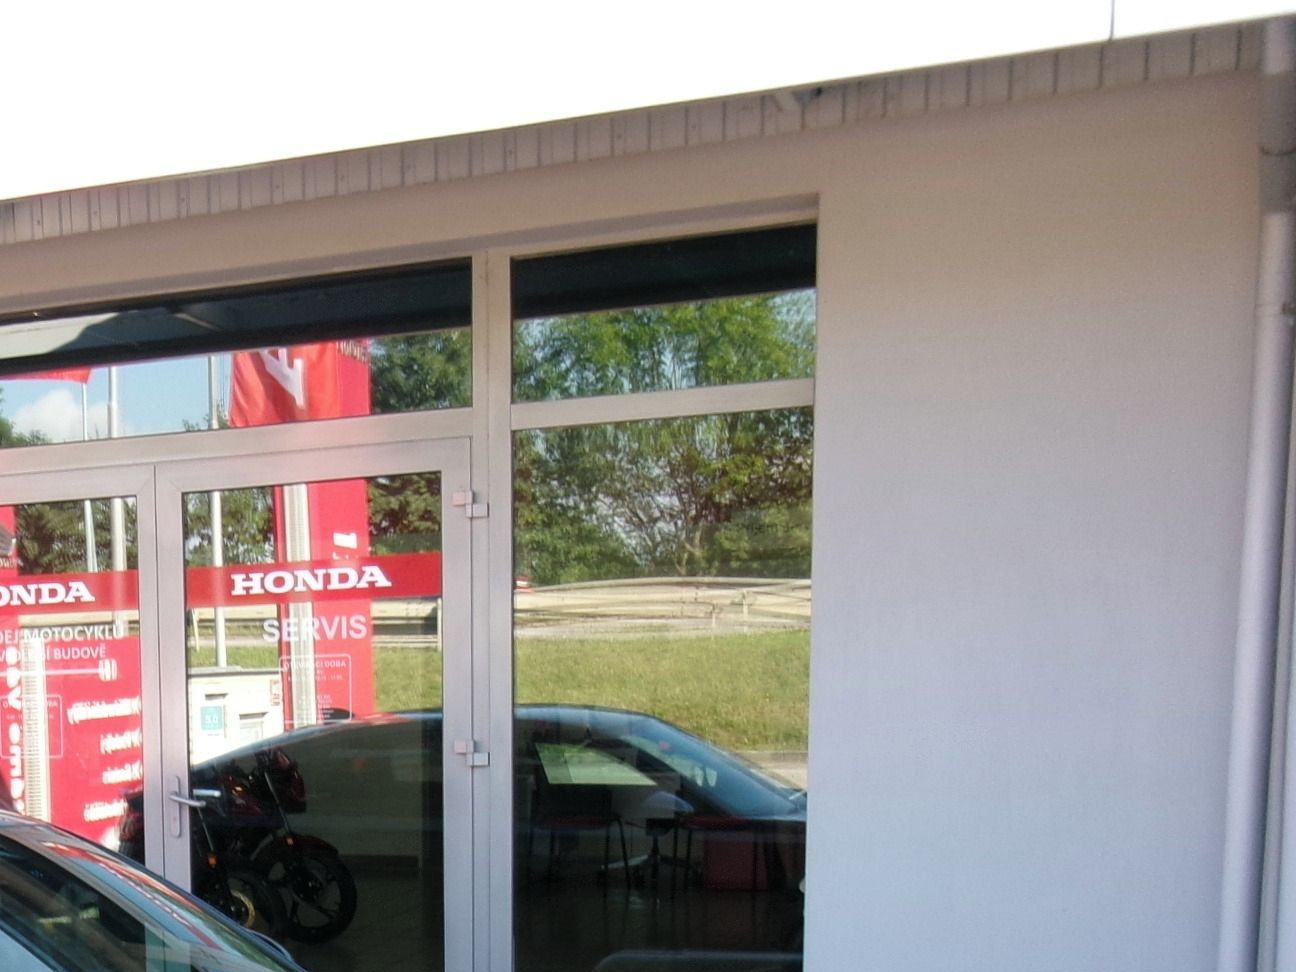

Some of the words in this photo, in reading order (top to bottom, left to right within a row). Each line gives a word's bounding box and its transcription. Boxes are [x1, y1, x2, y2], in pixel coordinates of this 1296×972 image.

[230, 565, 392, 596] HONDA
[262, 614, 368, 643] SERVIS
[54, 643, 106, 660] BUDOVĚ
